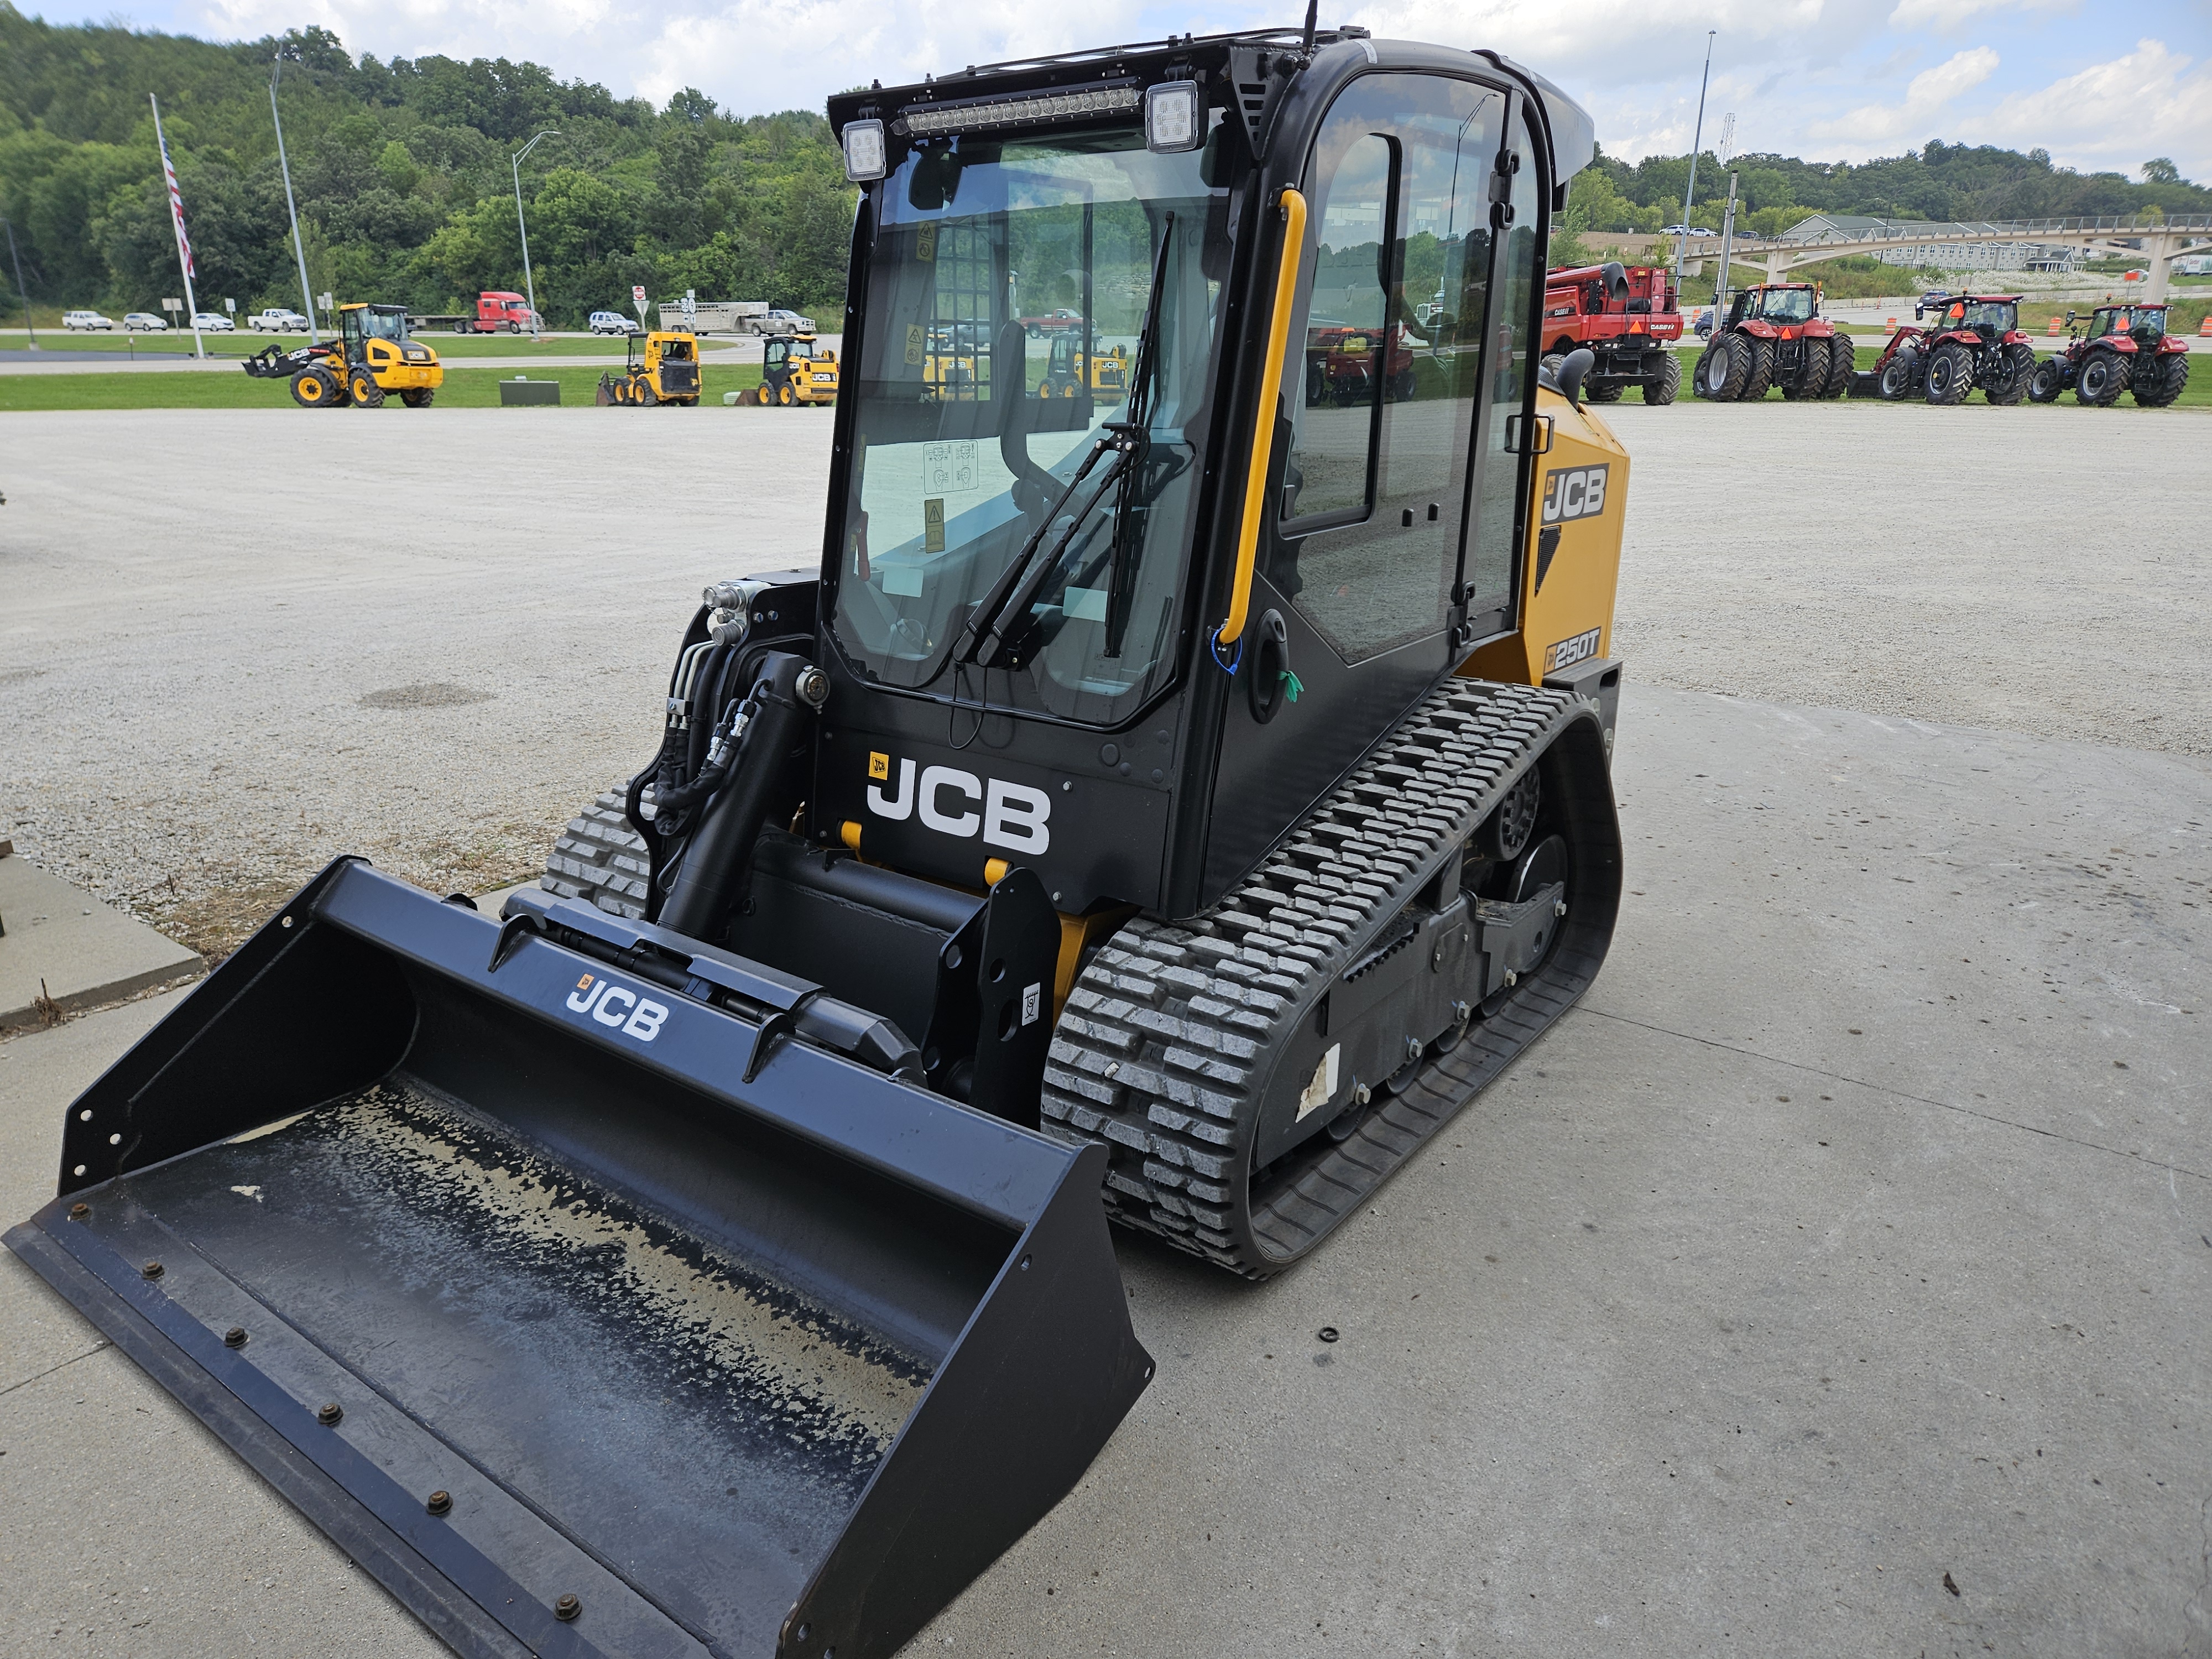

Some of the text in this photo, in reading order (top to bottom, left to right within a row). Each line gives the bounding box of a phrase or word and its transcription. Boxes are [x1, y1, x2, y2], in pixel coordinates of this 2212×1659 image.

[288, 348, 310, 361] JCB
[1543, 468, 1606, 521] JCB
[1554, 629, 1600, 669] 250T
[874, 759, 885, 771] JCB
[867, 758, 1051, 855] JCB
[566, 980, 669, 1041] JCB
